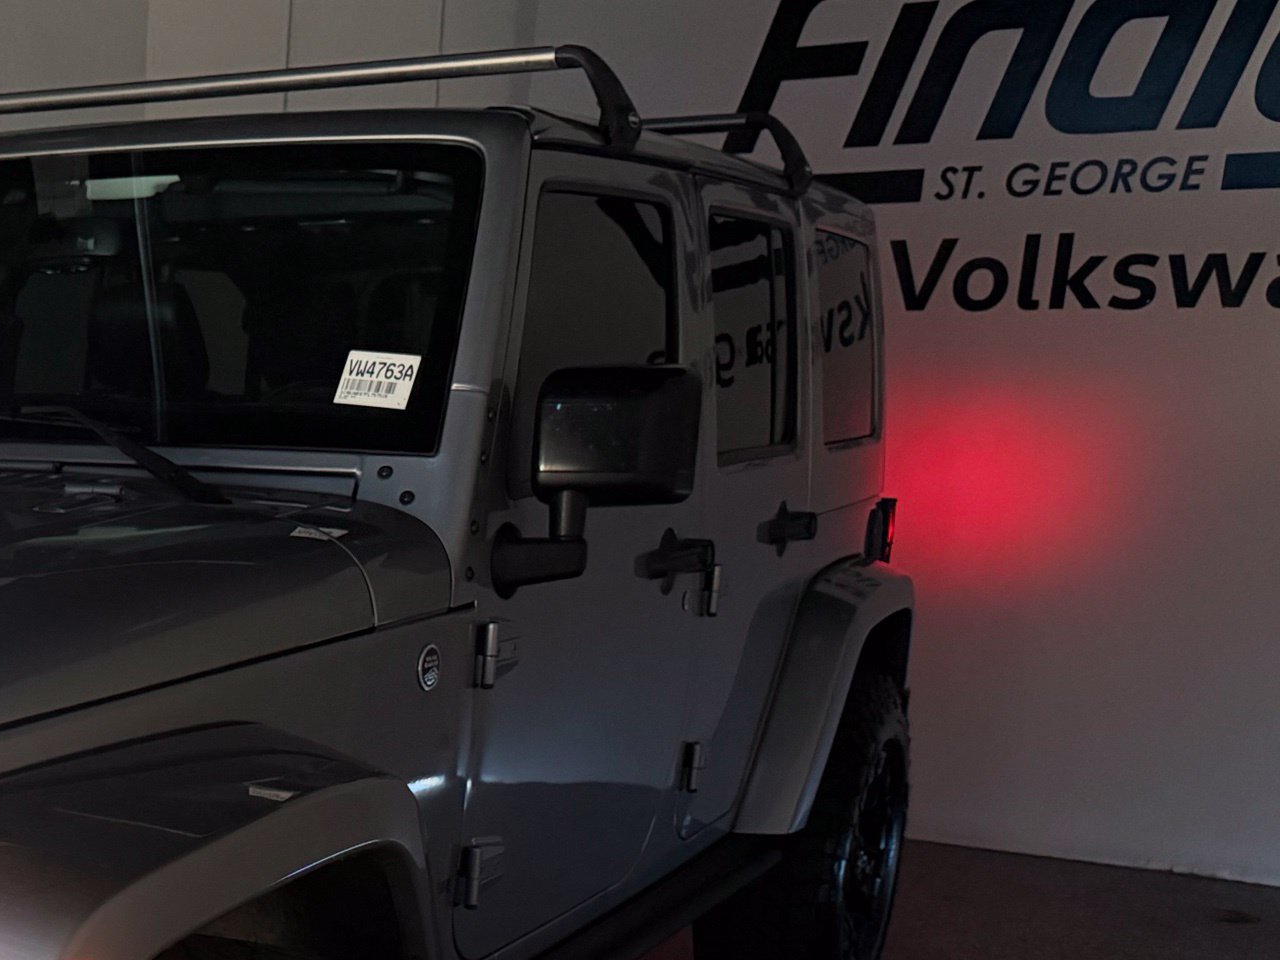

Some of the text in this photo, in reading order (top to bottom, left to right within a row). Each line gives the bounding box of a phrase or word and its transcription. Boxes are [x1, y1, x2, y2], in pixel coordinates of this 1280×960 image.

[722, 0, 1280, 153] Findl
[933, 156, 1209, 200] ST. GEORGE
[348, 359, 414, 381] VW4763A
